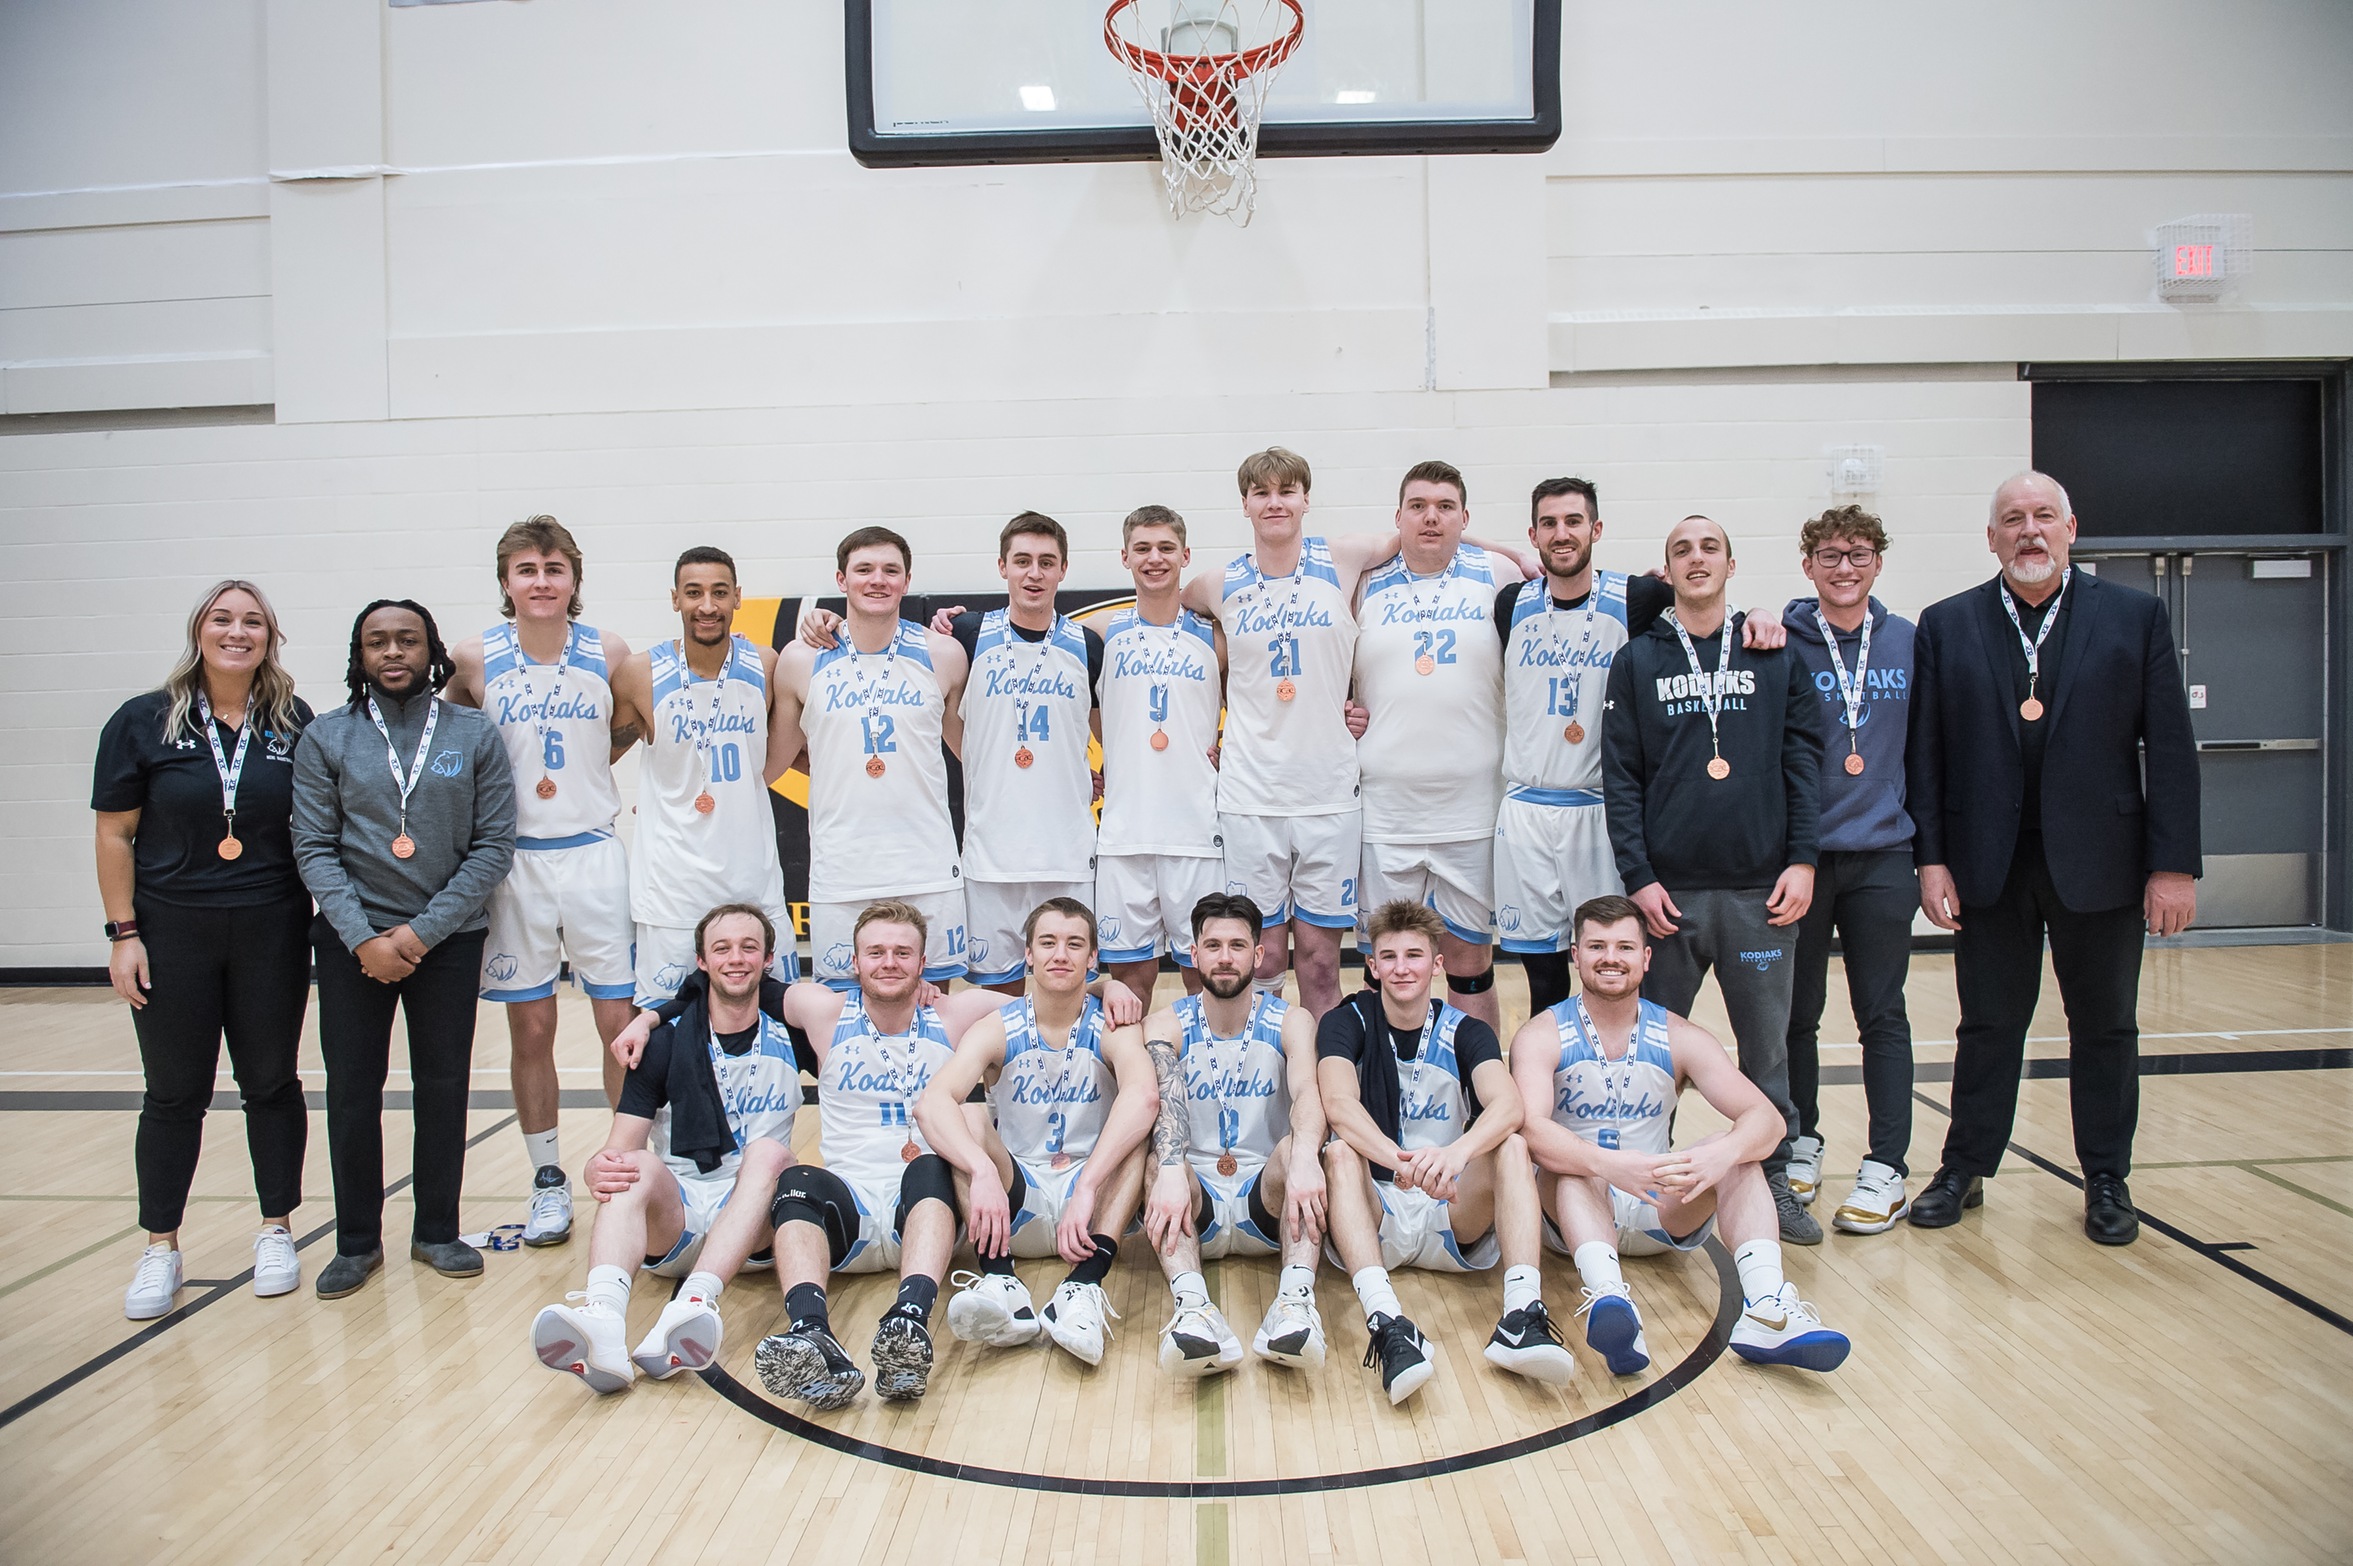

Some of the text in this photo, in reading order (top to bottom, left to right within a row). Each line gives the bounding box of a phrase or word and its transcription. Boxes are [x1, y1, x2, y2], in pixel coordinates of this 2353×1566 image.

[2175, 245, 2213, 276] EXIT
[1381, 598, 1485, 626] Koiaks
[1268, 638, 1302, 678] 21
[1413, 629, 1457, 664] 22
[986, 668, 1075, 699] Kodaks
[1547, 678, 1580, 717] 13
[498, 692, 599, 726] Kodaks
[1017, 705, 1050, 741] 14
[1667, 697, 1747, 716] BASKETALL
[544, 730, 565, 770] 6
[861, 715, 897, 754] 12
[711, 743, 741, 783] 10
[947, 925, 965, 956] 12
[1740, 949, 1782, 959] KODIAKS
[782, 951, 800, 982] 10
[1045, 1112, 1066, 1152] 3
